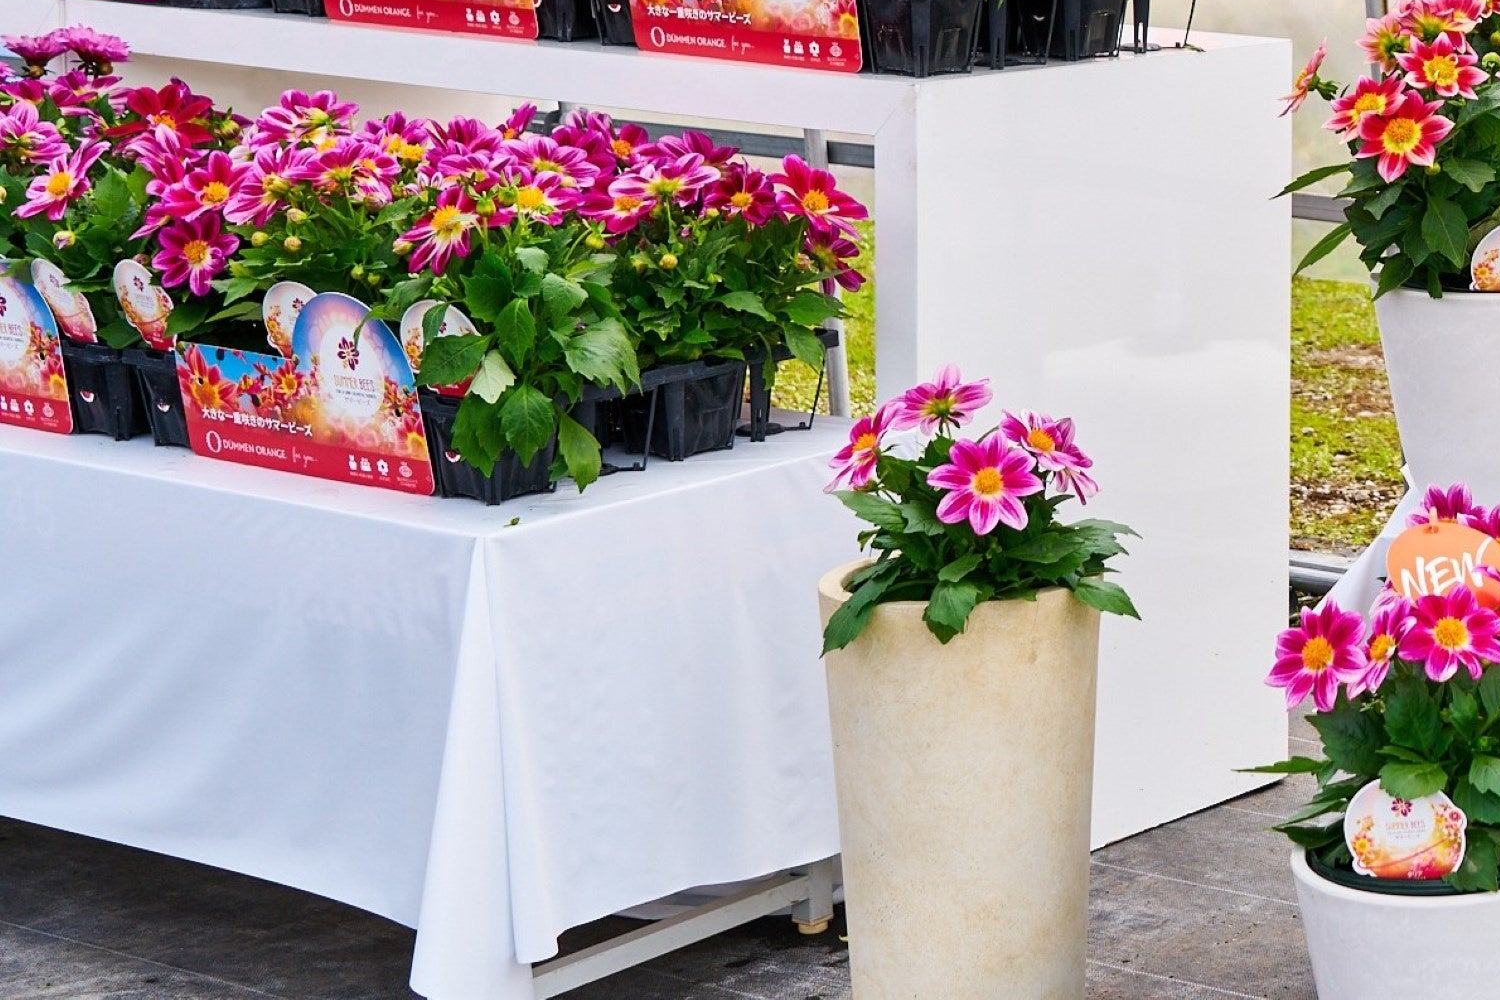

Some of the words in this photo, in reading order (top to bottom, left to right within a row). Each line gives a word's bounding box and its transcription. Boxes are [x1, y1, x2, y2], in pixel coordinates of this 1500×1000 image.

[383, 5, 411, 18] ORANGE
[697, 35, 726, 49] ORANGE
[255, 445, 287, 460] ORANGE
[1400, 537, 1493, 603] NEW
